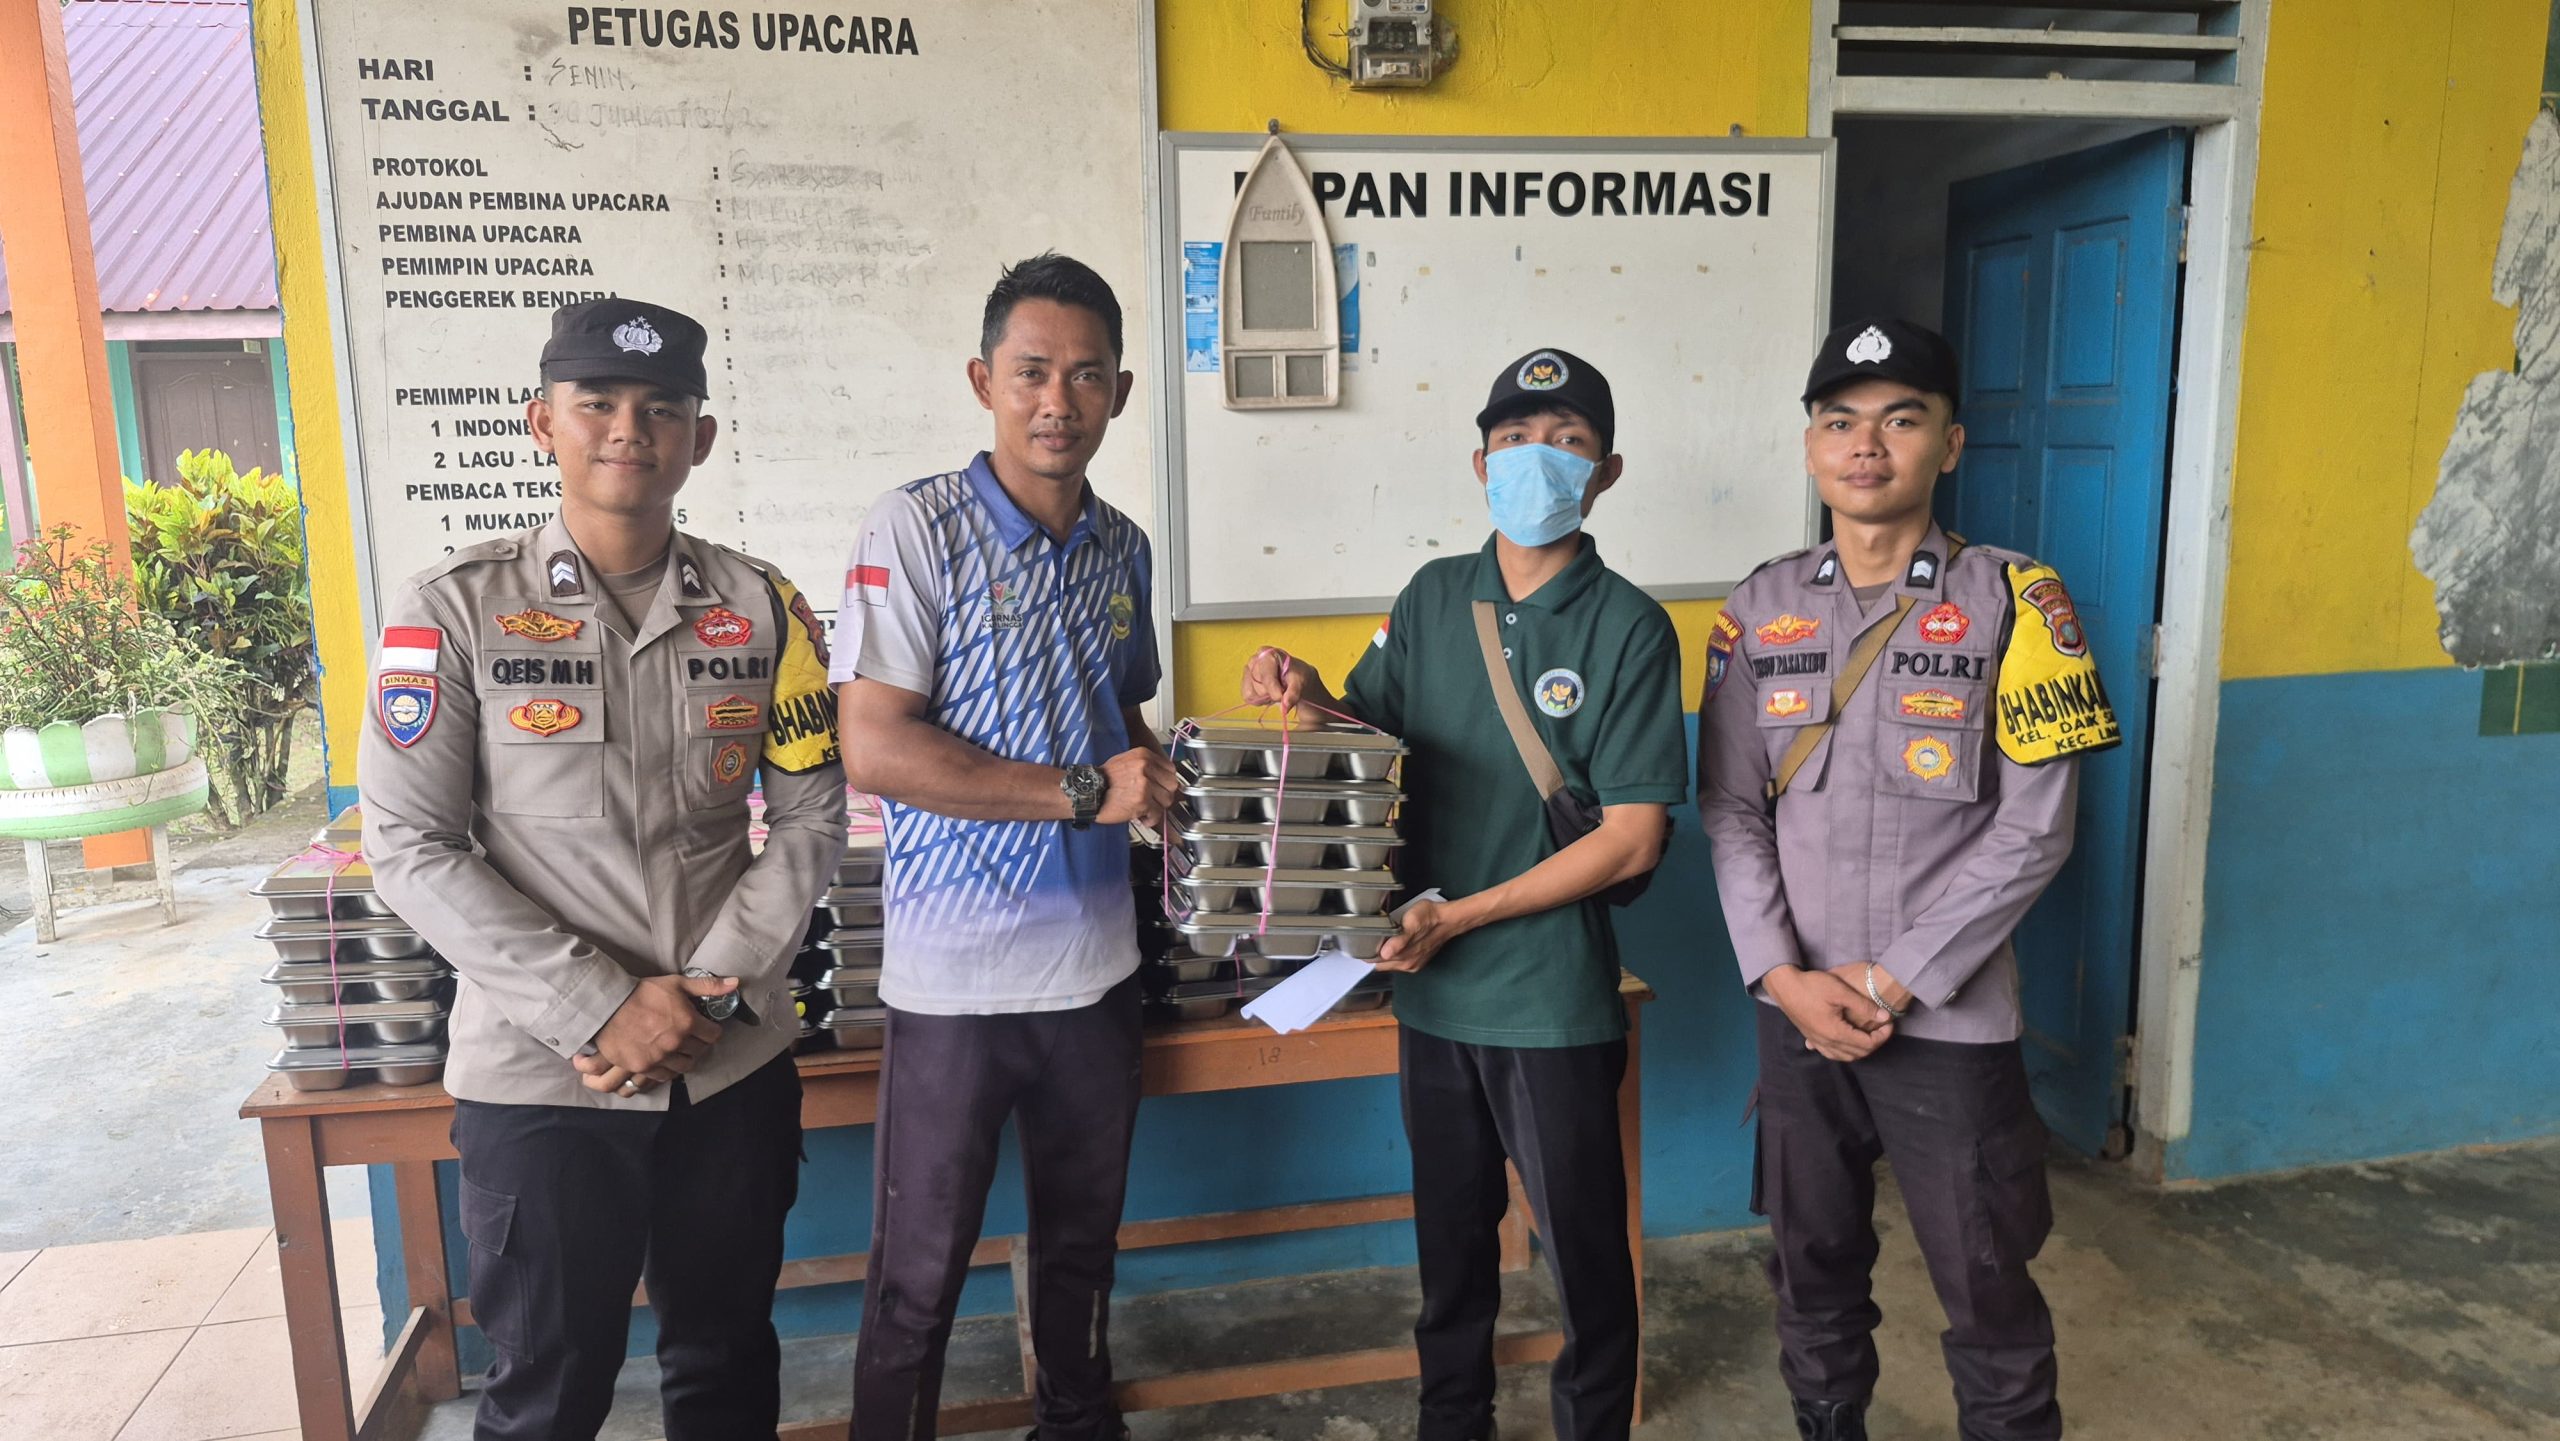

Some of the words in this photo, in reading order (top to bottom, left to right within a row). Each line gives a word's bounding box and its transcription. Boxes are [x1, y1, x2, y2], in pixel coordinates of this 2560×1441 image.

[567, 6, 740, 50] PETUGAS
[752, 12, 919, 56] UPACARA
[358, 58, 434, 81] HARI
[361, 98, 510, 122] TANGGAL
[372, 157, 488, 177] PROTOKOL
[376, 191, 463, 210] AJUDAN
[469, 191, 566, 211] PEMBINA
[572, 193, 670, 212] UPACARA
[1449, 171, 1771, 218] INFORMASI
[378, 224, 477, 243] PEMBINA
[482, 225, 582, 243] UPACARA
[381, 257, 488, 276] PEMIMPIN
[494, 257, 594, 276] UPACARA
[385, 290, 516, 309] PENGGEREK
[396, 387, 500, 406] PEMIMPIN
[431, 420, 440, 437] 1
[433, 451, 447, 469] 2
[458, 450, 515, 468] LAGU
[406, 482, 507, 501] PEMBACA
[441, 514, 450, 531] 1
[687, 656, 769, 681] POLRI
[1891, 651, 1985, 681] POLRI
[2016, 728, 2051, 748] KEL.
[2054, 733, 2093, 752] KEC.
